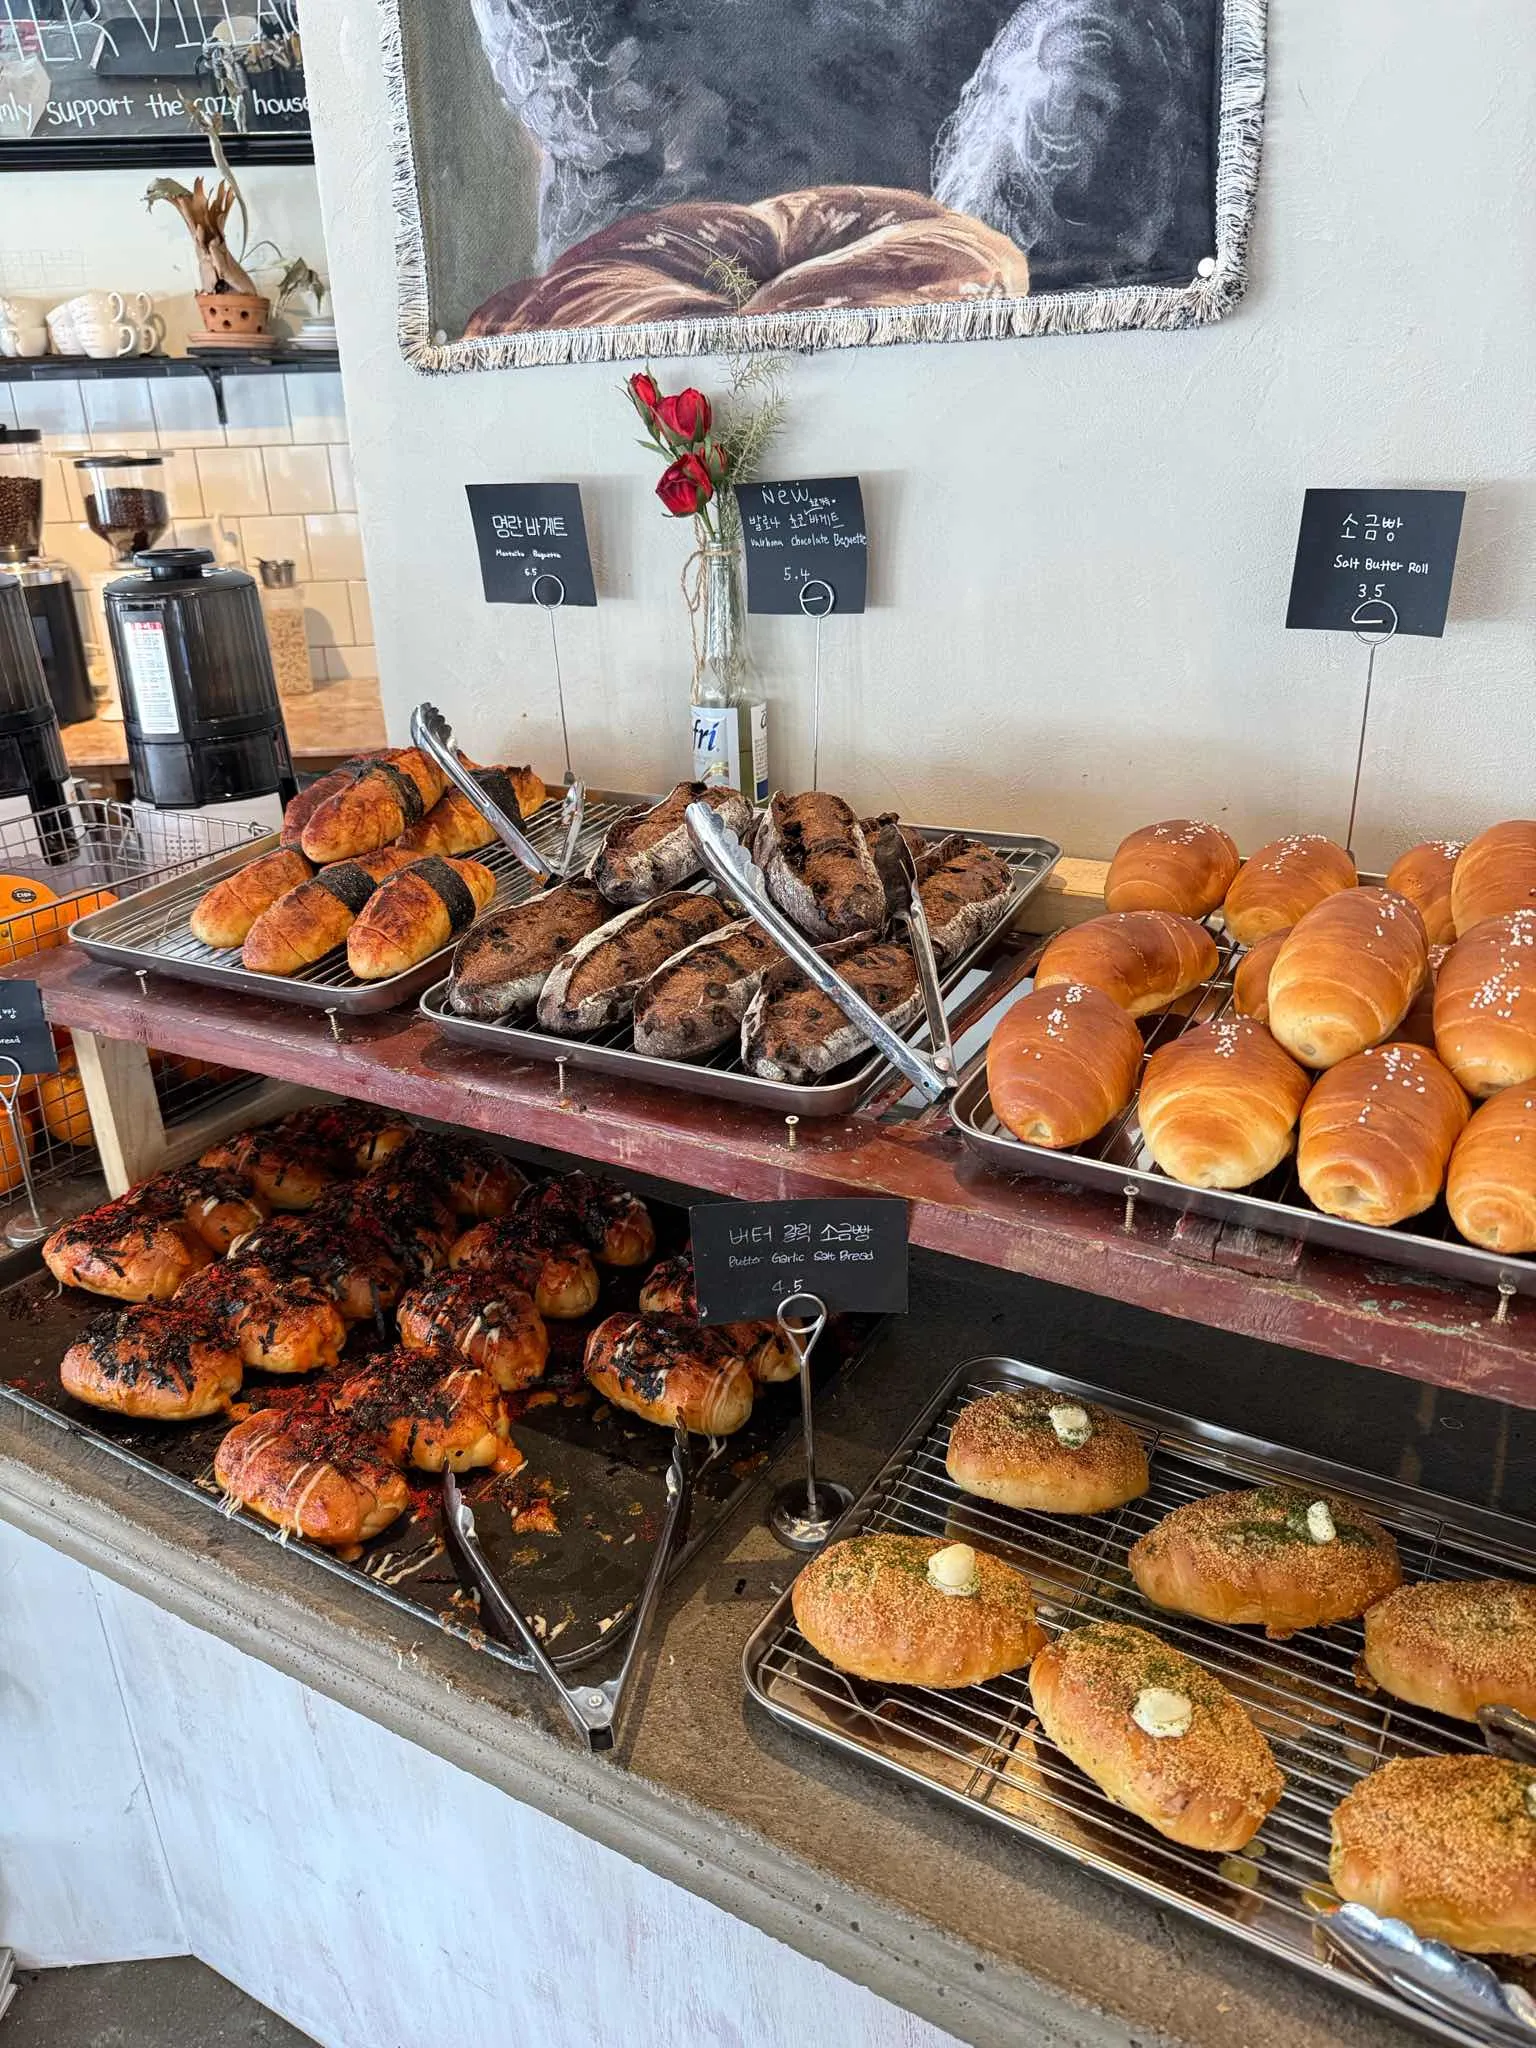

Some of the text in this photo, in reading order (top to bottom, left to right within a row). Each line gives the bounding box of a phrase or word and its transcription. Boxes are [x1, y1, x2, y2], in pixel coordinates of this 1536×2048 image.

[47, 95, 133, 128] support
[145, 93, 184, 119] the
[193, 94, 242, 120] cozy
[252, 90, 310, 116] house
[492, 515, 568, 538] 명란 바게트
[749, 511, 845, 531] 발로나 초코 바게트
[1341, 513, 1404, 541] 소금빵
[791, 534, 830, 546] Chocolate
[524, 568, 537, 576] 6.5
[1333, 554, 1428, 574] Salt Butter Roll
[783, 567, 810, 581] 5.4
[1358, 583, 1385, 599] 3.5
[728, 1222, 873, 1245] 버터 갈릭 소금빵
[728, 1249, 874, 1268] Butter Garlic Salt Bread
[771, 1279, 804, 1294] 4.5
